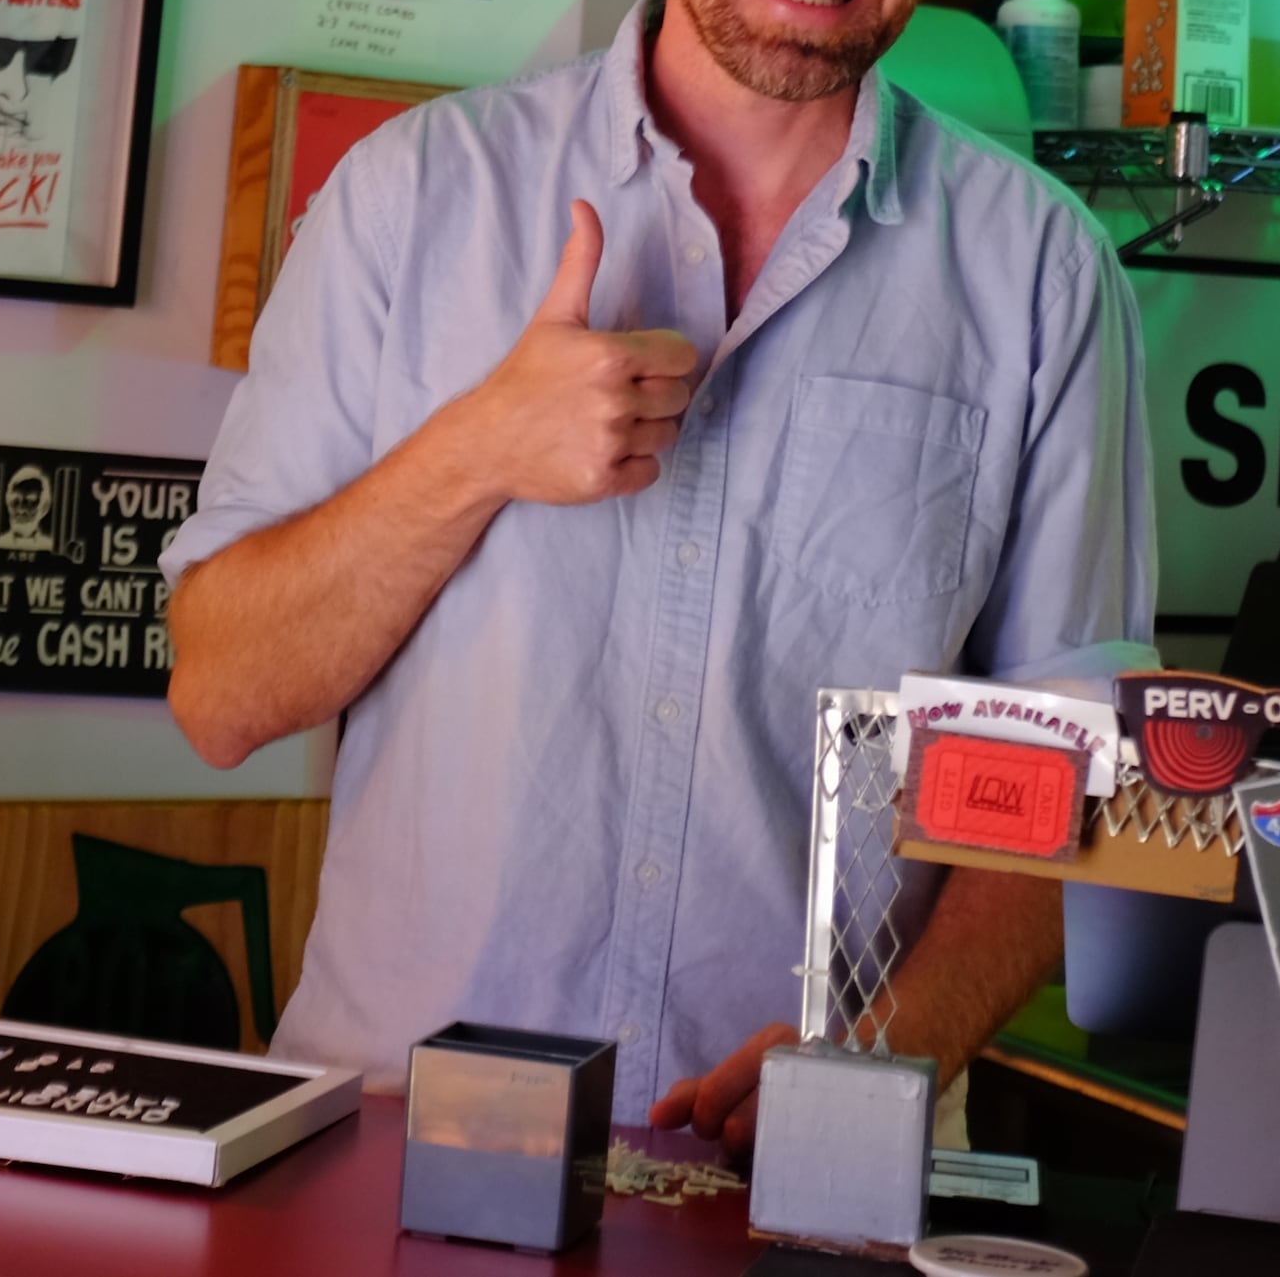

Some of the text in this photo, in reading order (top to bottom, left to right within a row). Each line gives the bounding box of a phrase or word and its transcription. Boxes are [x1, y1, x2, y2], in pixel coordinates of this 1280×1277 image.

[30, 151, 62, 176] you
[91, 481, 191, 520] YOUR
[101, 524, 138, 566] IS
[25, 576, 65, 609] WE
[80, 575, 148, 611] CAN'T
[36, 621, 129, 669] CASH
[906, 698, 1107, 756] NOW AVAILABLE
[939, 768, 1054, 828] GIFT LOW CARD
